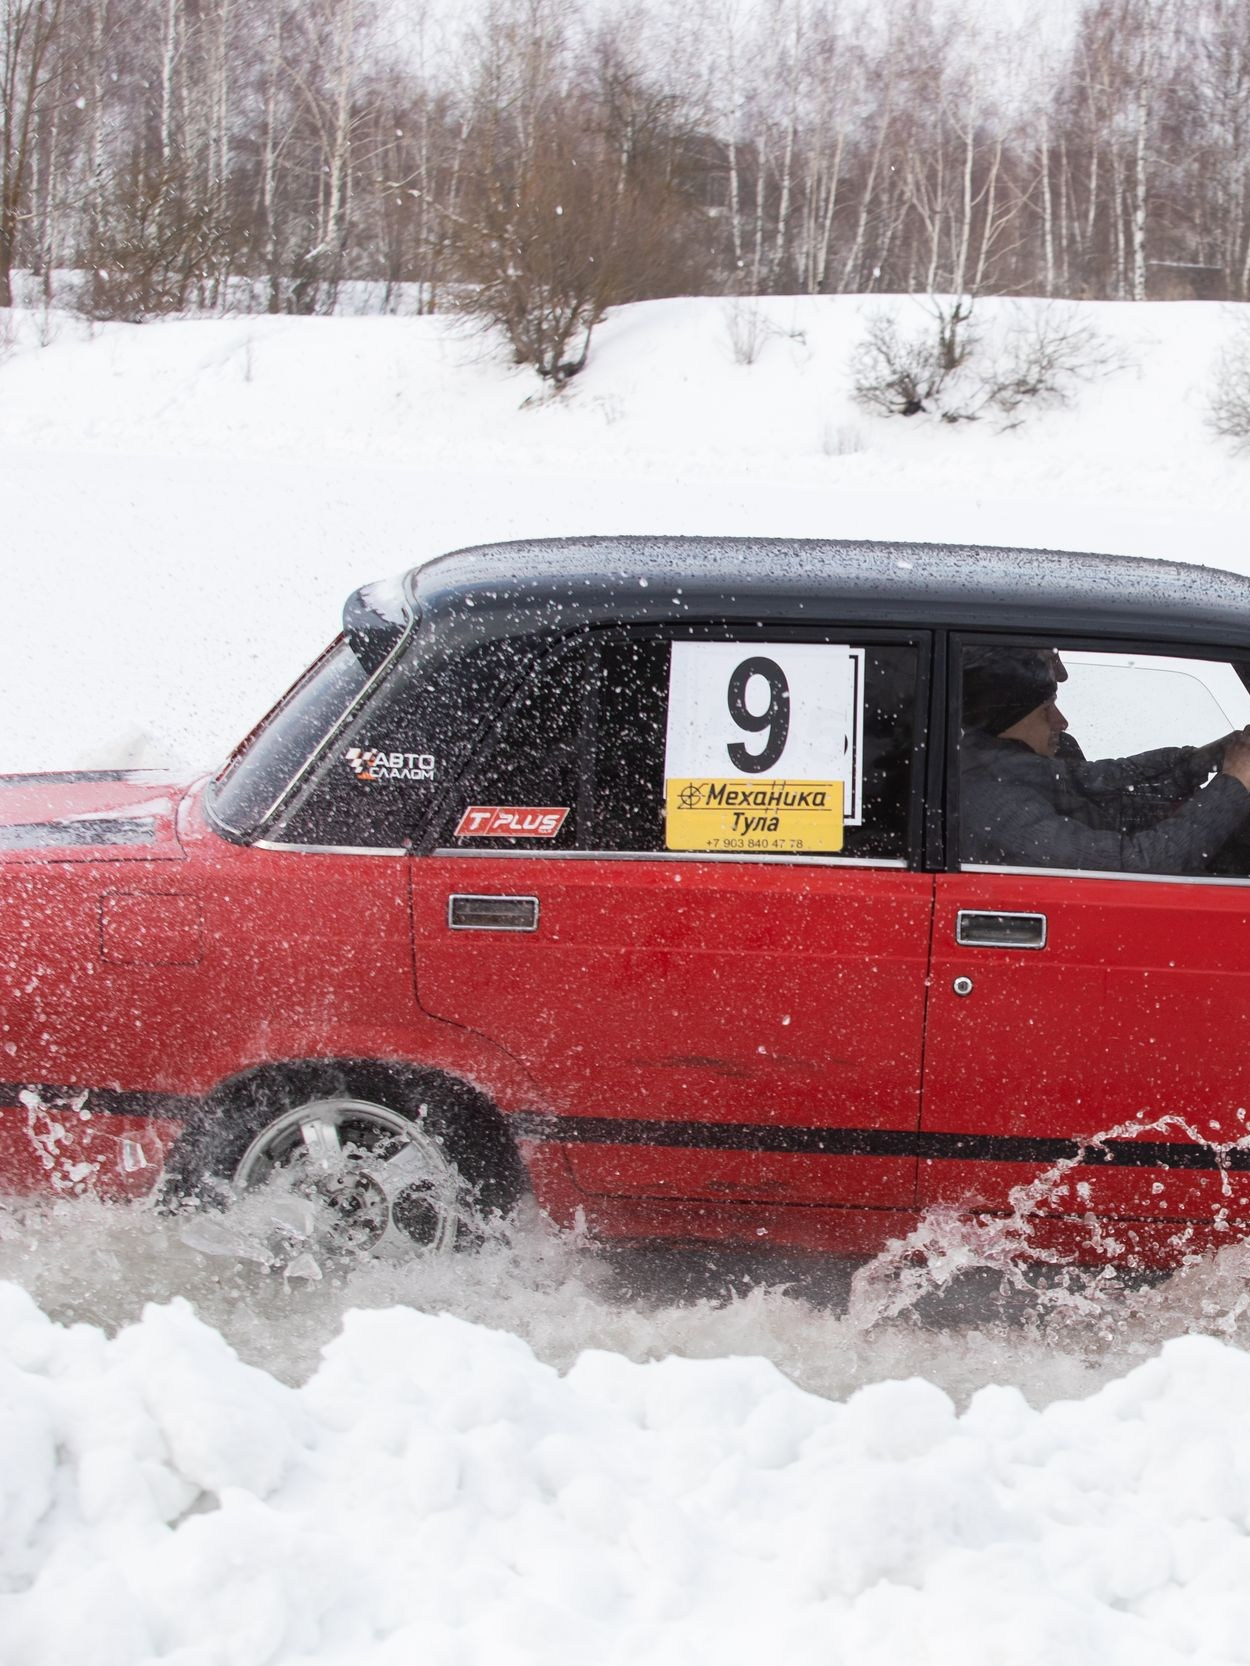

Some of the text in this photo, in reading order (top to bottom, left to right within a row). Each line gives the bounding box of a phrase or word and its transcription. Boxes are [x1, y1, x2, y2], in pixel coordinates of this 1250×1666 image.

[727, 656, 791, 774] 9
[374, 752, 435, 770] АВТО
[369, 766, 434, 780] СЛАЛОМ
[705, 783, 827, 807] Механика
[470, 812, 561, 831] T PLUS
[731, 812, 780, 836] Тула
[706, 838, 804, 849] +7 903 840 47 78
